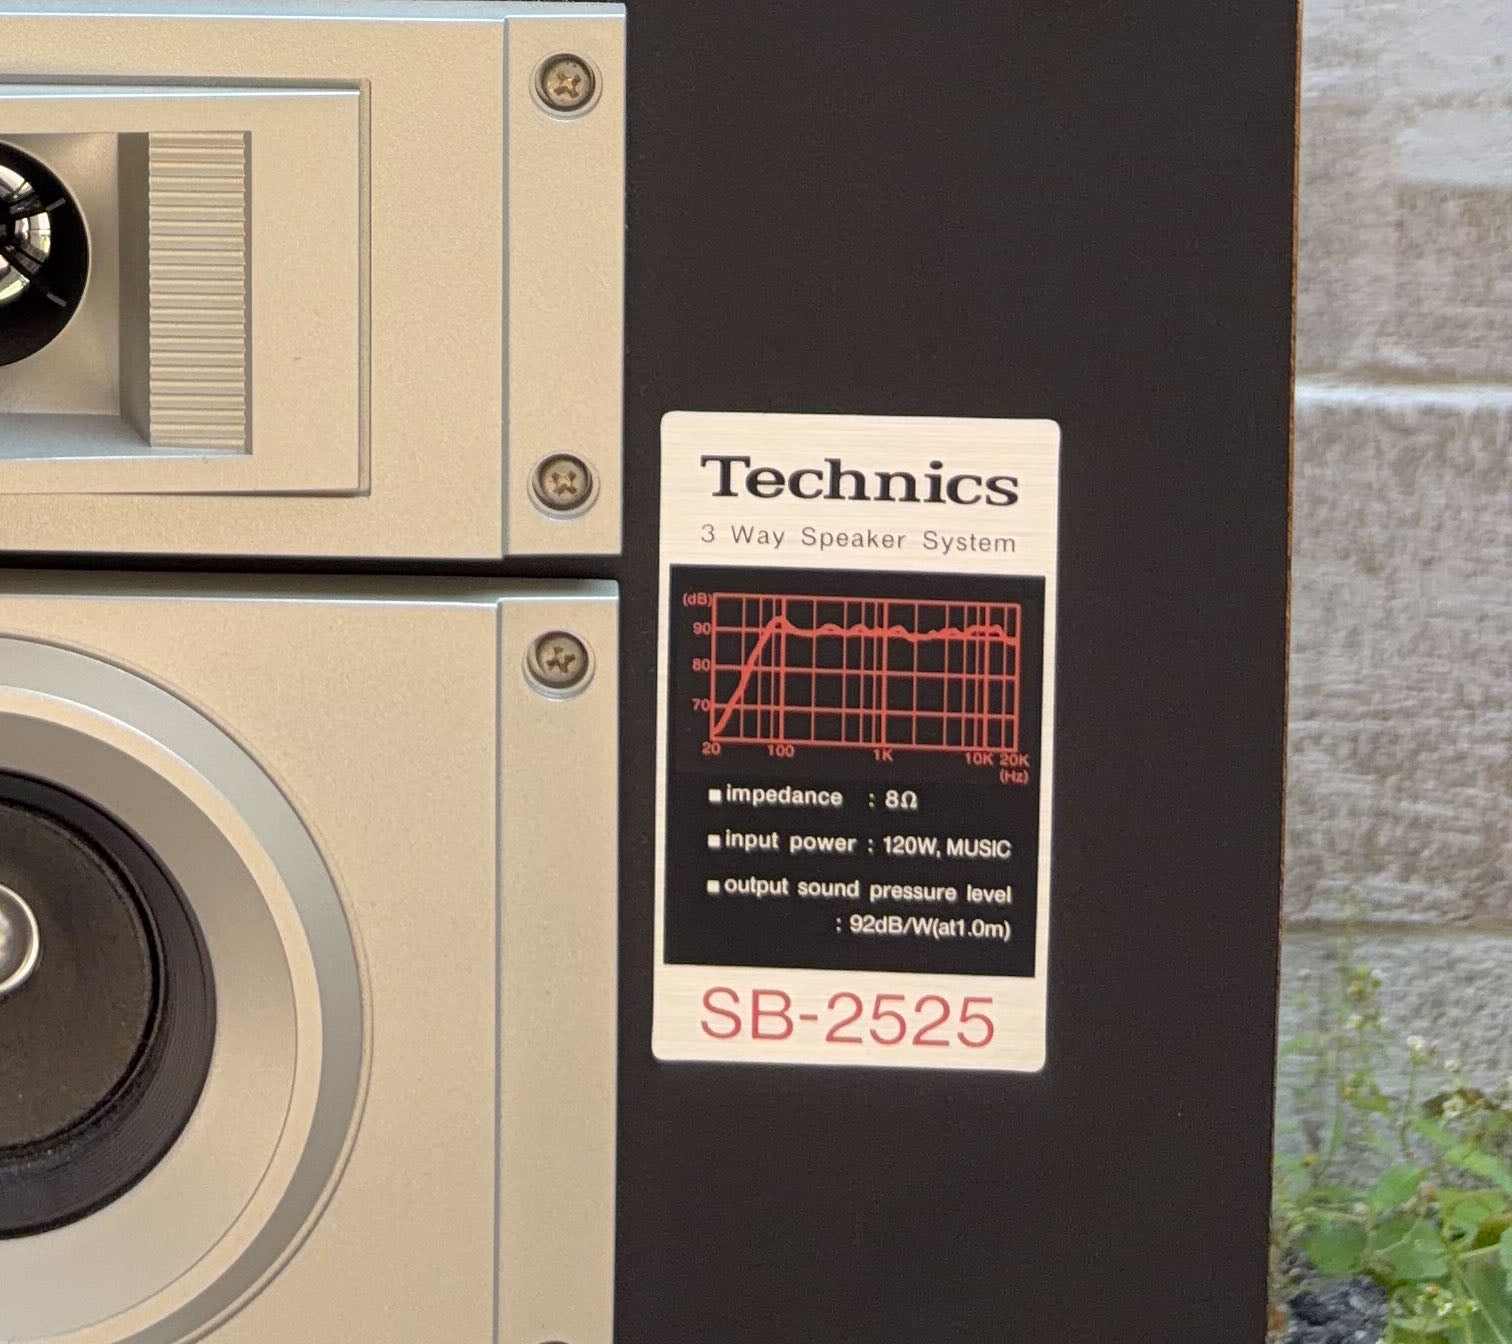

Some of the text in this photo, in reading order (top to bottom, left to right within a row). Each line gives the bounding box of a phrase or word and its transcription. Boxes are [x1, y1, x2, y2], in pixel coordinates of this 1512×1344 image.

[700, 454, 1020, 507] Technics
[701, 523, 1017, 555] 3 Way Speaker System
[682, 592, 714, 609] (dB)
[692, 622, 712, 636] 90
[692, 658, 712, 673] 80
[692, 698, 711, 712] 70
[701, 742, 1030, 768] 20 100 1K 10K 20K
[999, 769, 1030, 786] (Hz)
[726, 785, 844, 809] impedance
[725, 830, 779, 853] input
[790, 835, 857, 855] power
[882, 836, 942, 859] 120W,
[946, 838, 1013, 859] MUSIC
[724, 877, 1013, 904] output sound pressure level
[700, 985, 996, 1049] SB-2525
